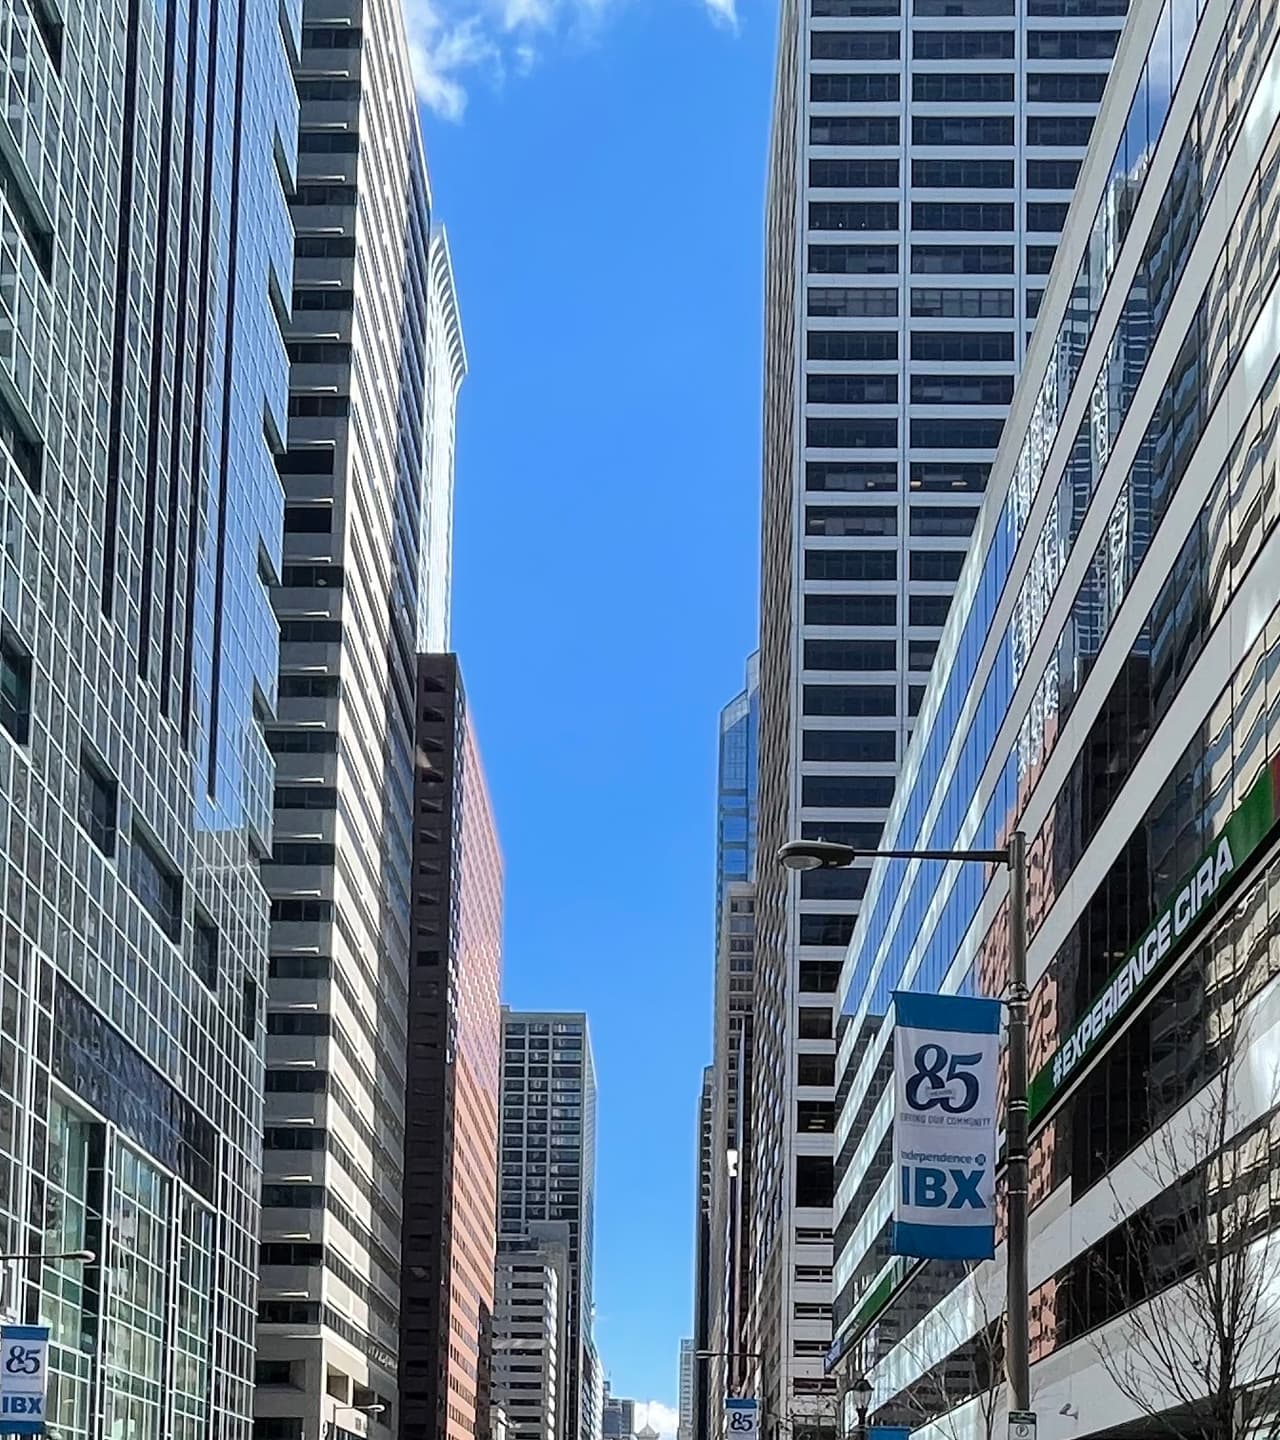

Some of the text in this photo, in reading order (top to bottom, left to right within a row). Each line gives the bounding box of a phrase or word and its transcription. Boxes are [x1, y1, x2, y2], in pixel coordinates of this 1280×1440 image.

[1052, 836, 1234, 1088] #EXPERIENCE CIRA
[905, 1043, 983, 1114] 85
[901, 1166, 987, 1209] IBX
[6, 1345, 41, 1374] 85
[2, 1396, 43, 1414] IBX
[730, 1411, 754, 1432] 85
